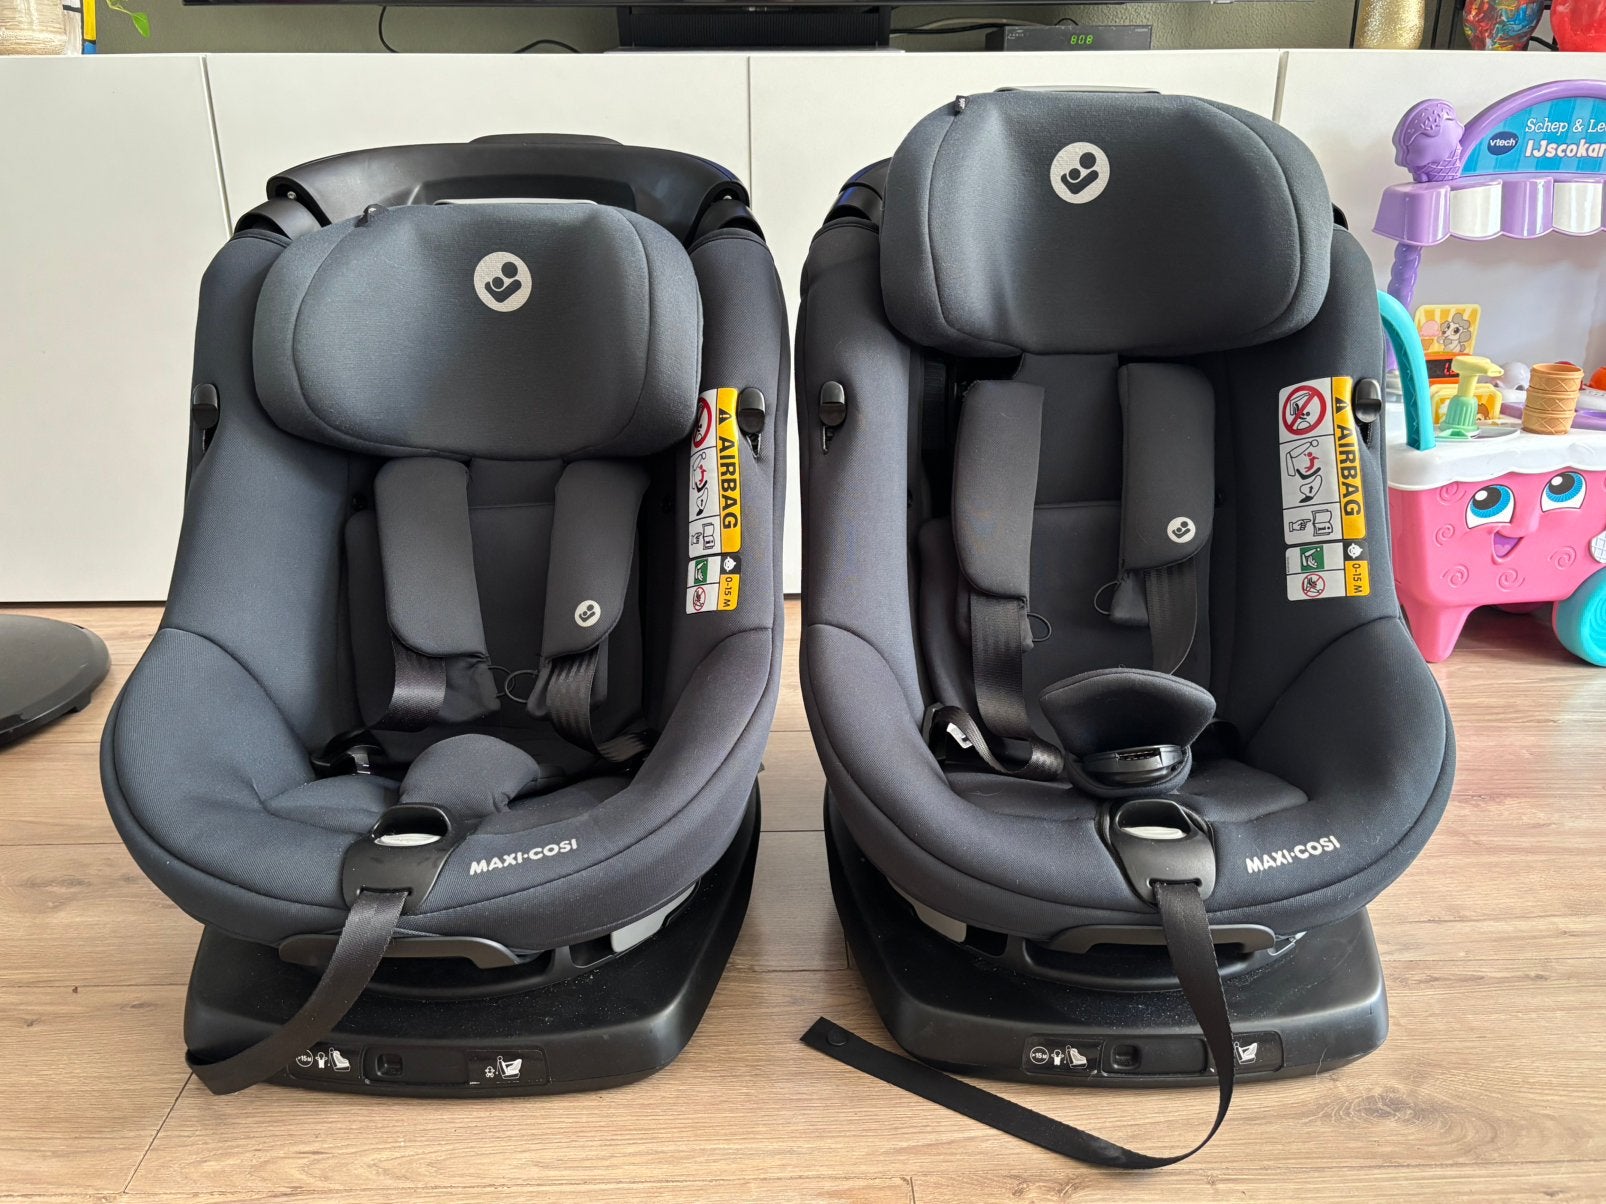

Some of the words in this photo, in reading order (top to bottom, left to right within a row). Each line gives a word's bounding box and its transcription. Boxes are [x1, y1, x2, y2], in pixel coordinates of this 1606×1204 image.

[1070, 34, 1094, 45] 808
[1525, 117, 1569, 136] Schep
[1572, 118, 1585, 133] &
[1587, 119, 1606, 133] Le
[1489, 137, 1517, 147] vtech
[1335, 424, 1362, 517] AIRBAG
[718, 435, 739, 530] AIRBAG
[1351, 563, 1362, 582] 0-15
[724, 576, 733, 596] 0-15
[1353, 584, 1363, 594] M
[722, 598, 731, 608] M
